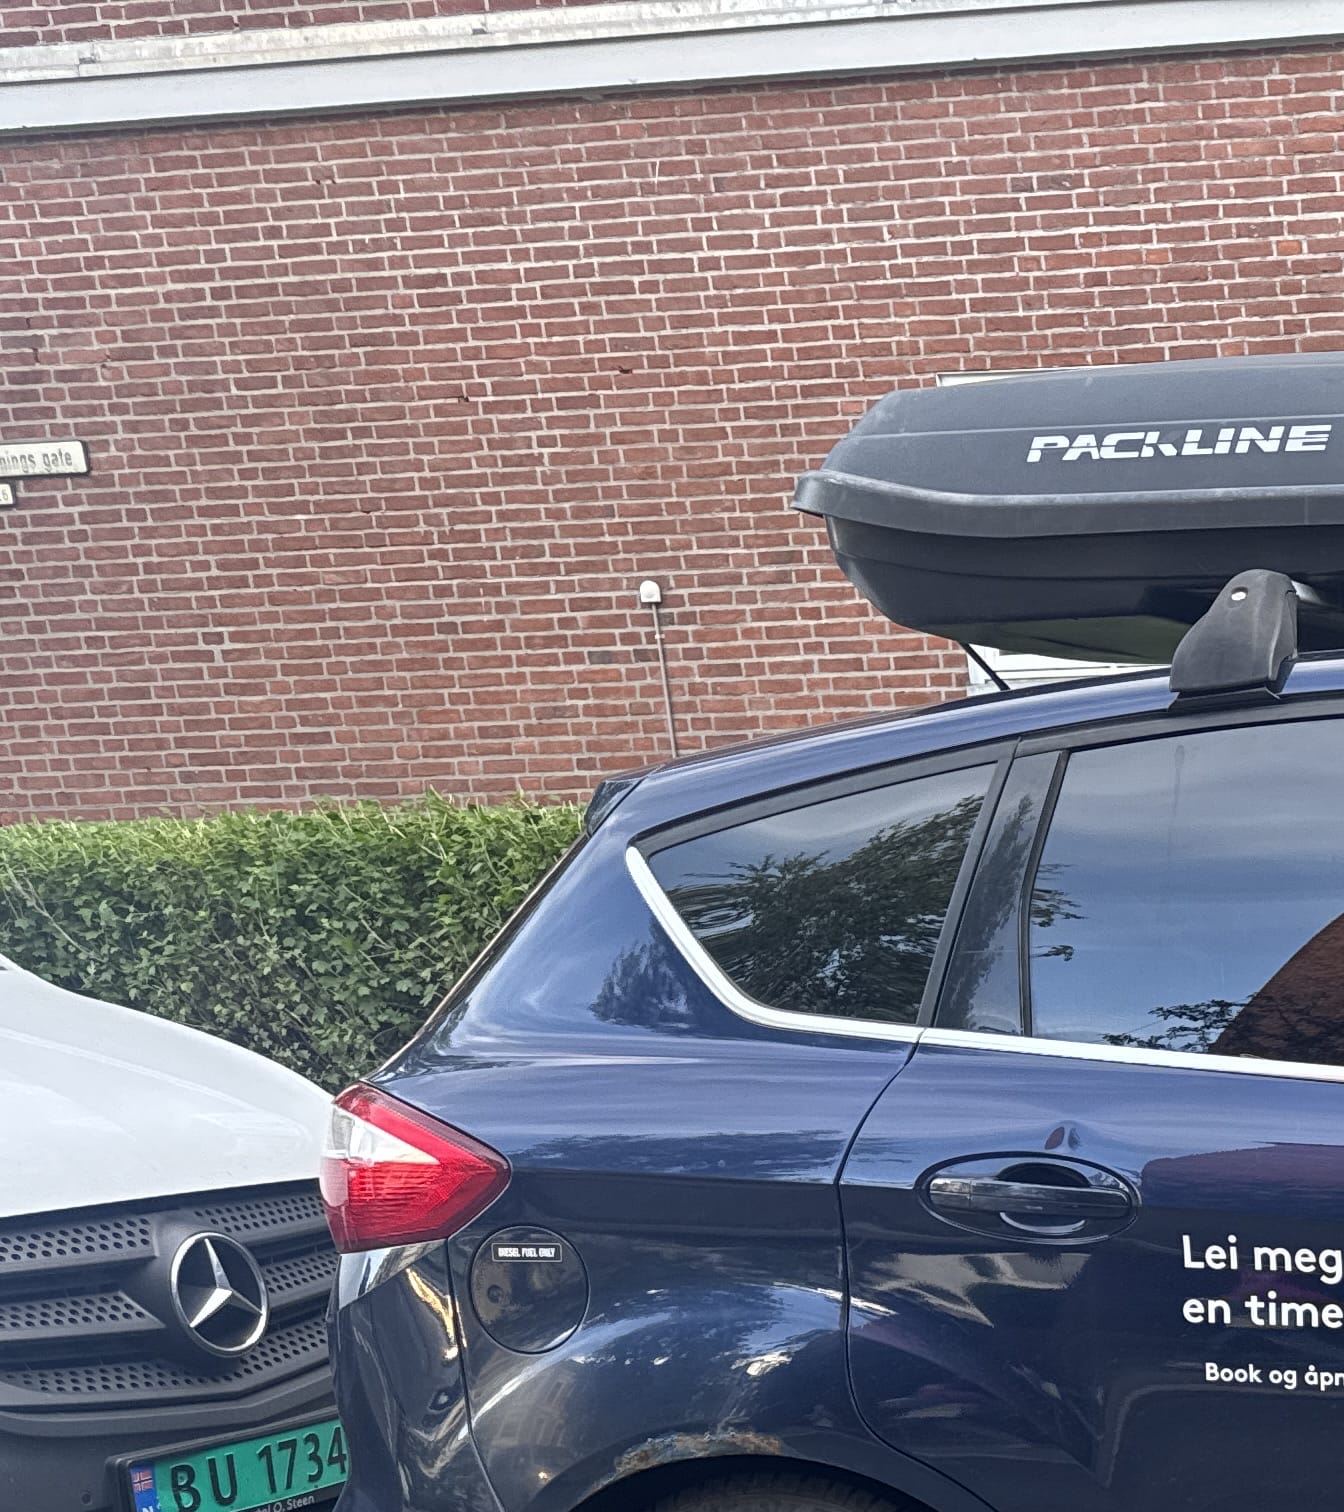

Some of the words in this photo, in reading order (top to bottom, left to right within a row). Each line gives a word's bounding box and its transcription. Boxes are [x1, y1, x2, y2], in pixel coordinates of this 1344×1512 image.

[42, 448, 73, 473] gate
[1026, 424, 1332, 463] PACKLINE
[497, 1247, 521, 1258] DIESEL
[521, 1247, 538, 1258] FUEL
[538, 1247, 556, 1258] ONLY
[1181, 1234, 1239, 1270] Lei
[1253, 1244, 1344, 1285] meg
[1182, 1297, 1232, 1325] en
[1244, 1290, 1344, 1329] time
[1204, 1361, 1263, 1384] Book
[1268, 1367, 1298, 1390] og
[257, 1426, 347, 1494] 1734
[286, 1494, 316, 1512] Steen
